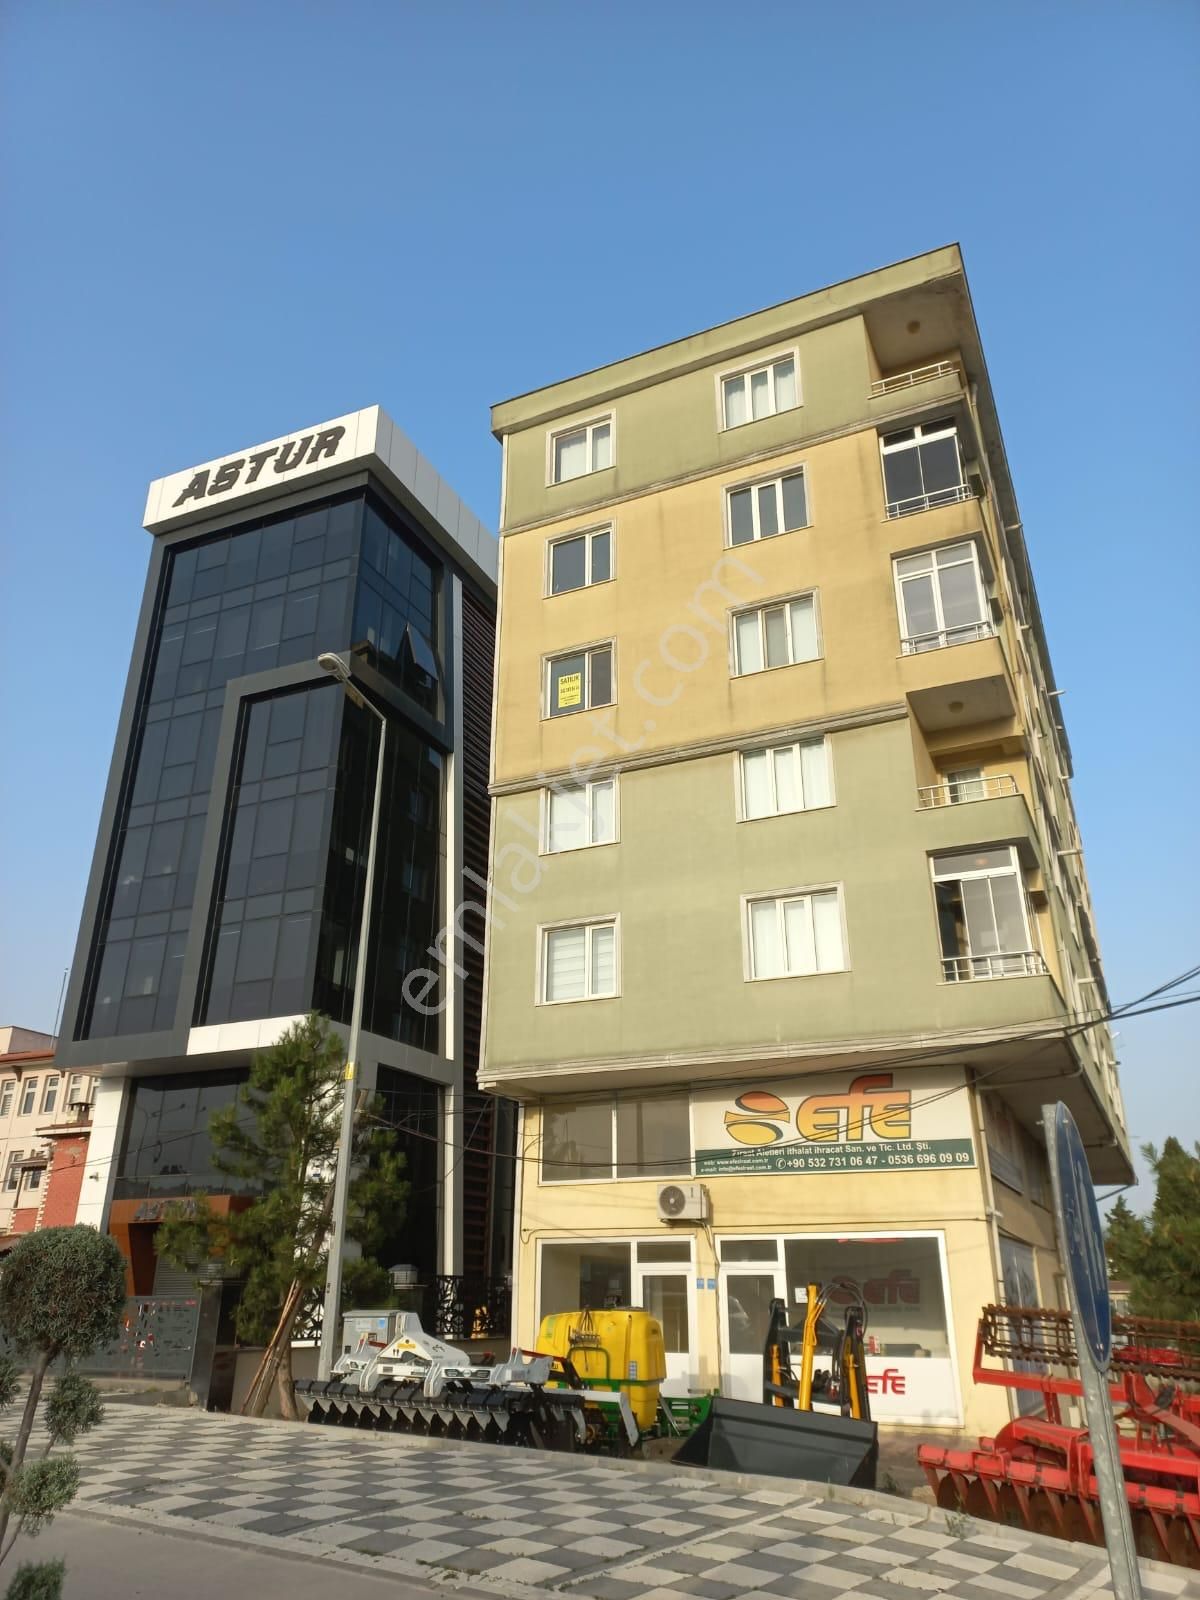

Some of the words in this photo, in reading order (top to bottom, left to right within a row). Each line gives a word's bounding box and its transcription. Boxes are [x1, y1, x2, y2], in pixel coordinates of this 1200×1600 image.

[171, 425, 346, 508] ASTUR
[845, 1145, 865, 1153] San.
[879, 1143, 895, 1152] Tic.
[897, 1142, 914, 1151] Ltd.
[916, 1142, 932, 1152] Şti.
[808, 1158, 826, 1167] 532
[829, 1157, 847, 1167] 731
[850, 1156, 863, 1166] 06
[865, 1156, 878, 1165] 47
[888, 1154, 914, 1165] 0536
[916, 1153, 936, 1164] 696
[939, 1153, 952, 1163] 09
[956, 1152, 969, 1162] 09
